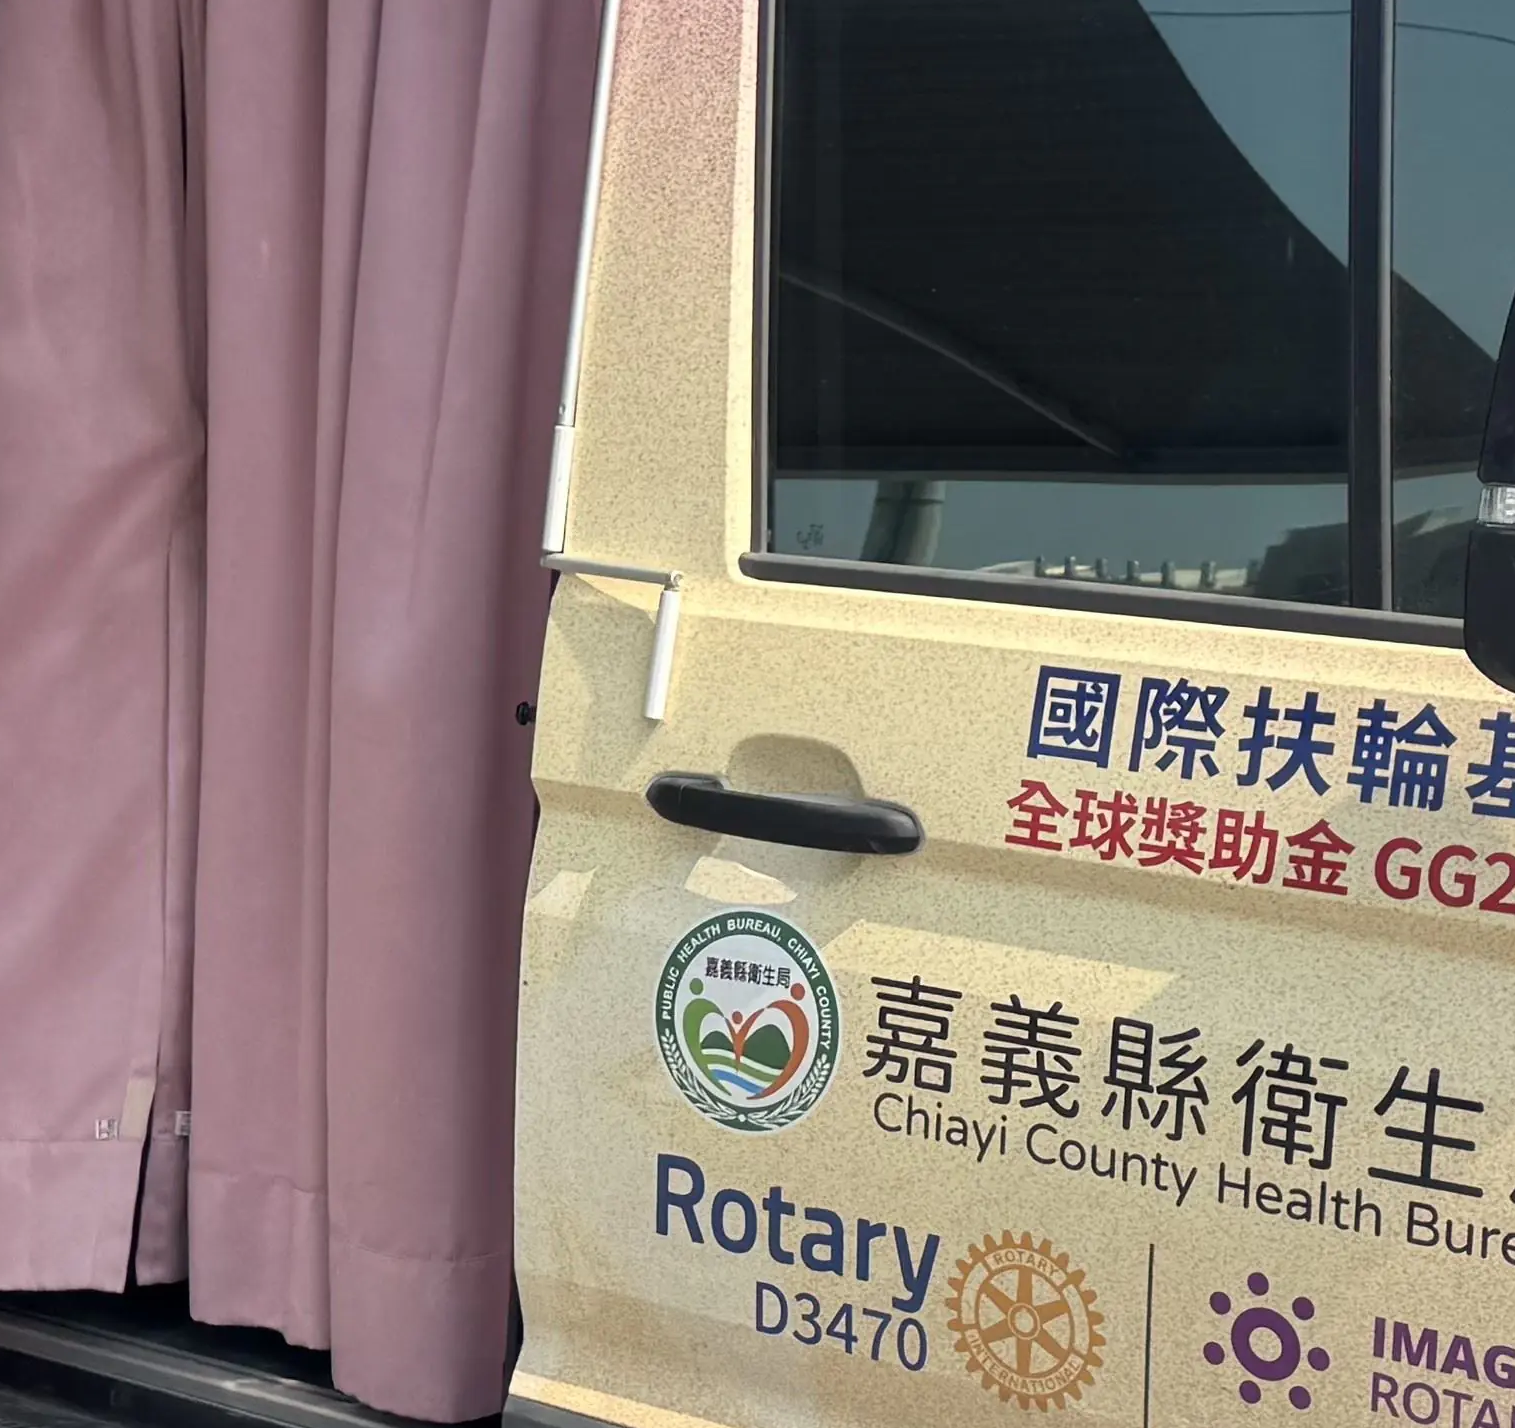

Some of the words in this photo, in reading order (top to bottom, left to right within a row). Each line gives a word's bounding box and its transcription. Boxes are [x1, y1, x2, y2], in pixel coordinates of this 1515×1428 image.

[1004, 779, 1356, 897] 全球獎助金
[661, 966, 679, 1020] PUBLIC
[676, 922, 721, 964] HEALTH
[787, 937, 821, 981] CHIAYI
[815, 985, 832, 1050] COUNTY
[704, 956, 792, 989] 嘉義縣衛生局
[872, 1090, 1010, 1161] Chiayi
[1025, 1120, 1199, 1208] County
[1216, 1162, 1383, 1237] Health
[654, 1153, 942, 1315] Rotary
[992, 1250, 1062, 1277] ROTARY
[754, 1279, 930, 1373] D3470
[967, 1333, 1081, 1394] INTERNATIONAL
